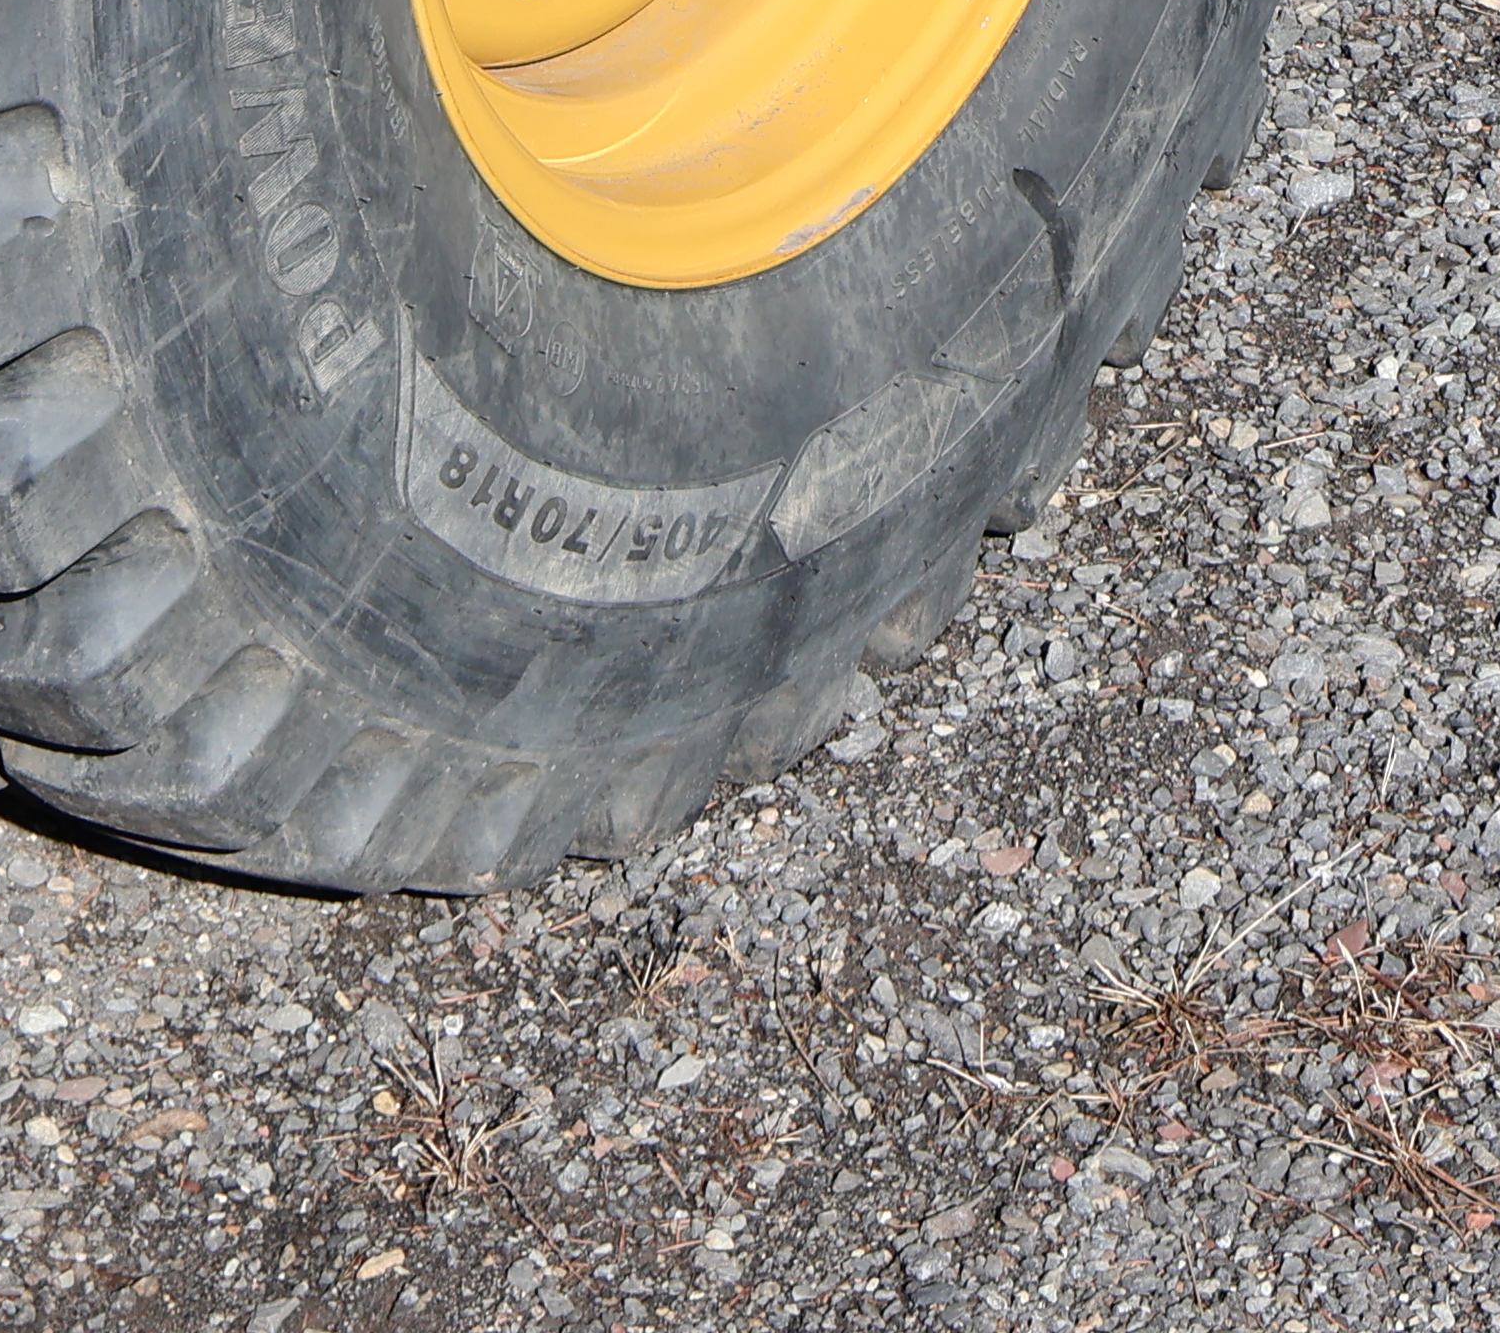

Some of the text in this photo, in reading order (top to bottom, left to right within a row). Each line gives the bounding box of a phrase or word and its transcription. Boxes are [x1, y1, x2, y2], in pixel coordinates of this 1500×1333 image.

[1017, 36, 1088, 146] RADIAL
[890, 173, 1000, 302] TUBELESS
[438, 443, 726, 563] 405/70R18
